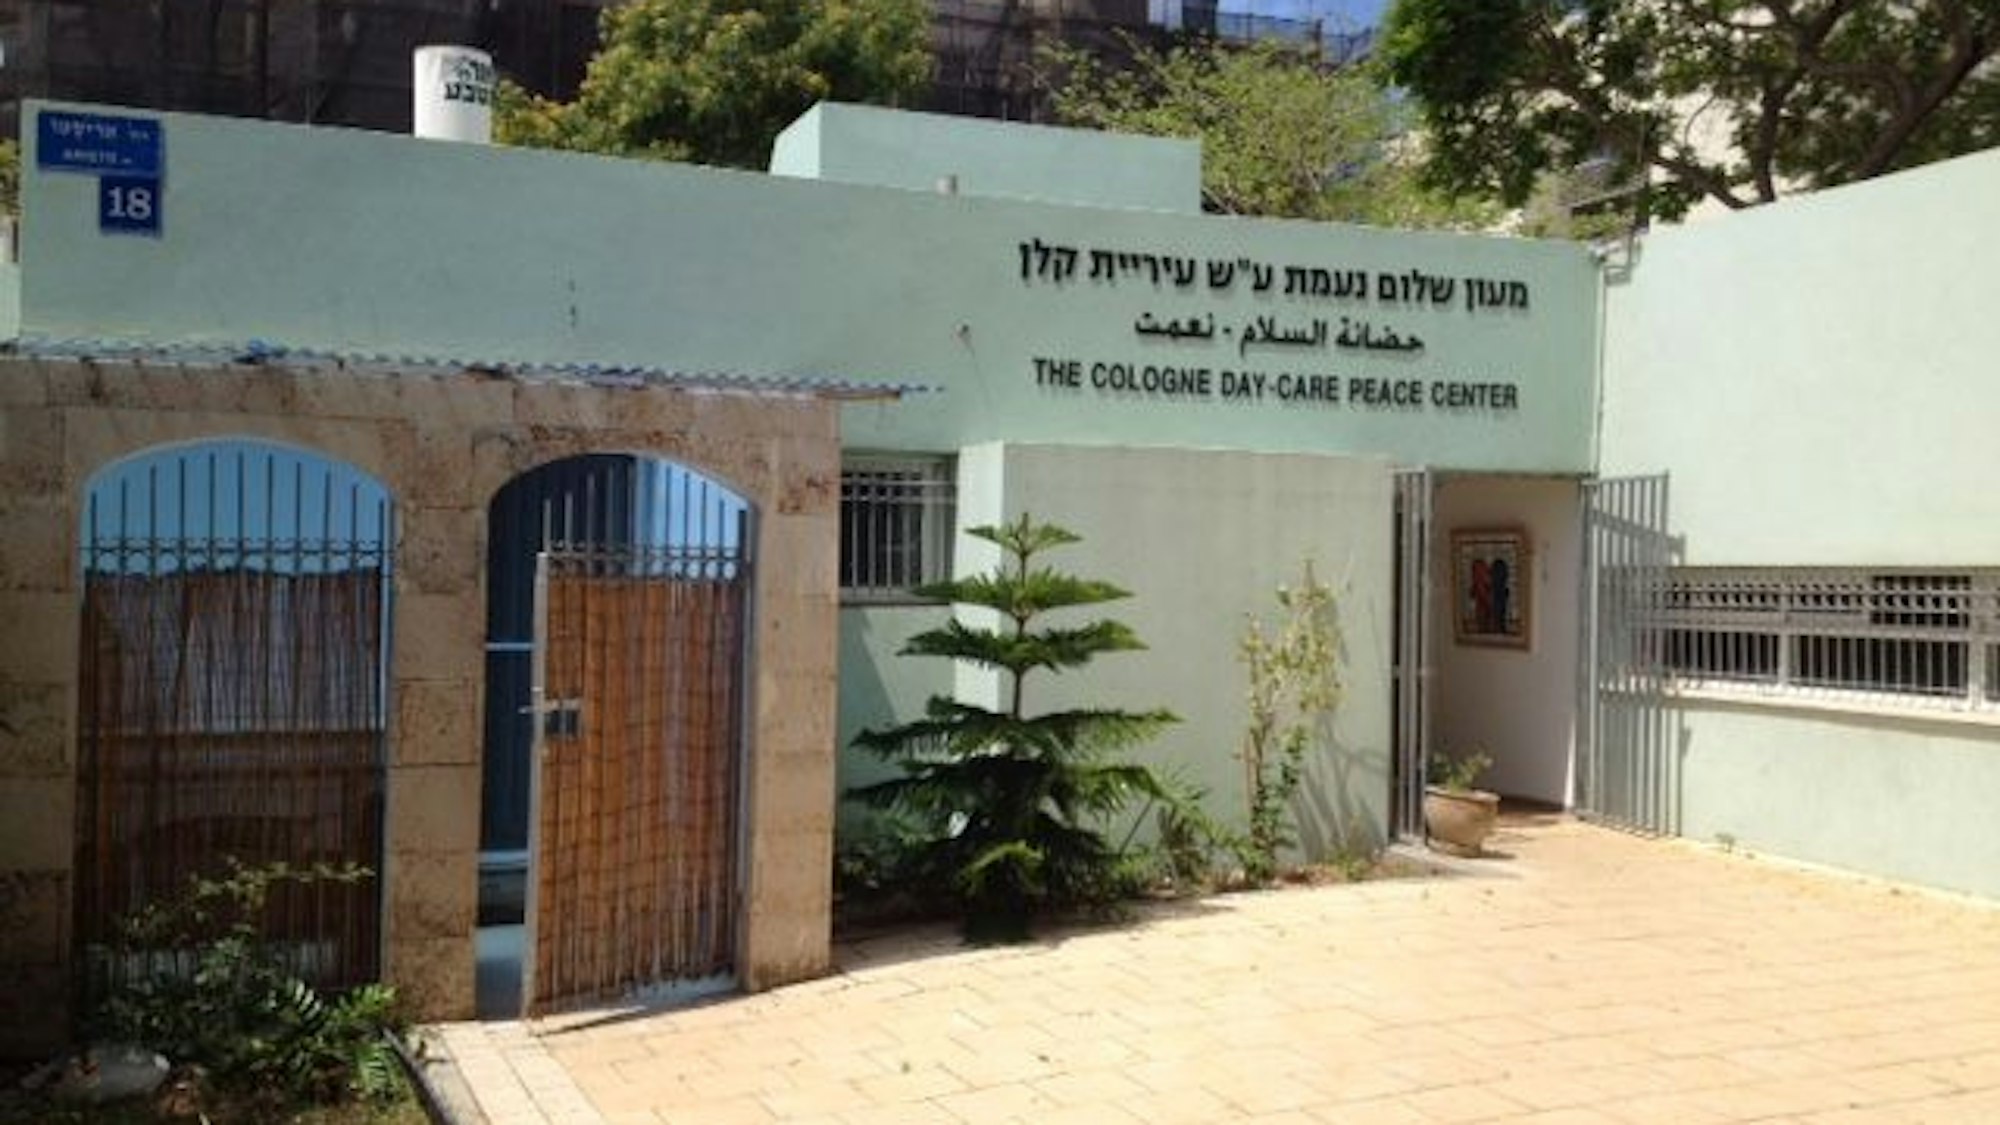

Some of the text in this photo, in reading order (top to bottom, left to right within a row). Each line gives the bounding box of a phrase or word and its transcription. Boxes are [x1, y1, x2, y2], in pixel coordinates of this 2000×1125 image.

[107, 186, 153, 220] 18
[1019, 237, 1529, 312] מעון שלום נעמת ע"ש עיריית קלן
[1135, 312, 1215, 339] نعمت
[1239, 316, 1328, 358] السلام
[1336, 317, 1424, 351] حضانة
[1032, 358, 1519, 410] THE COLOGNE DAY-CARE PEACE CENTER
